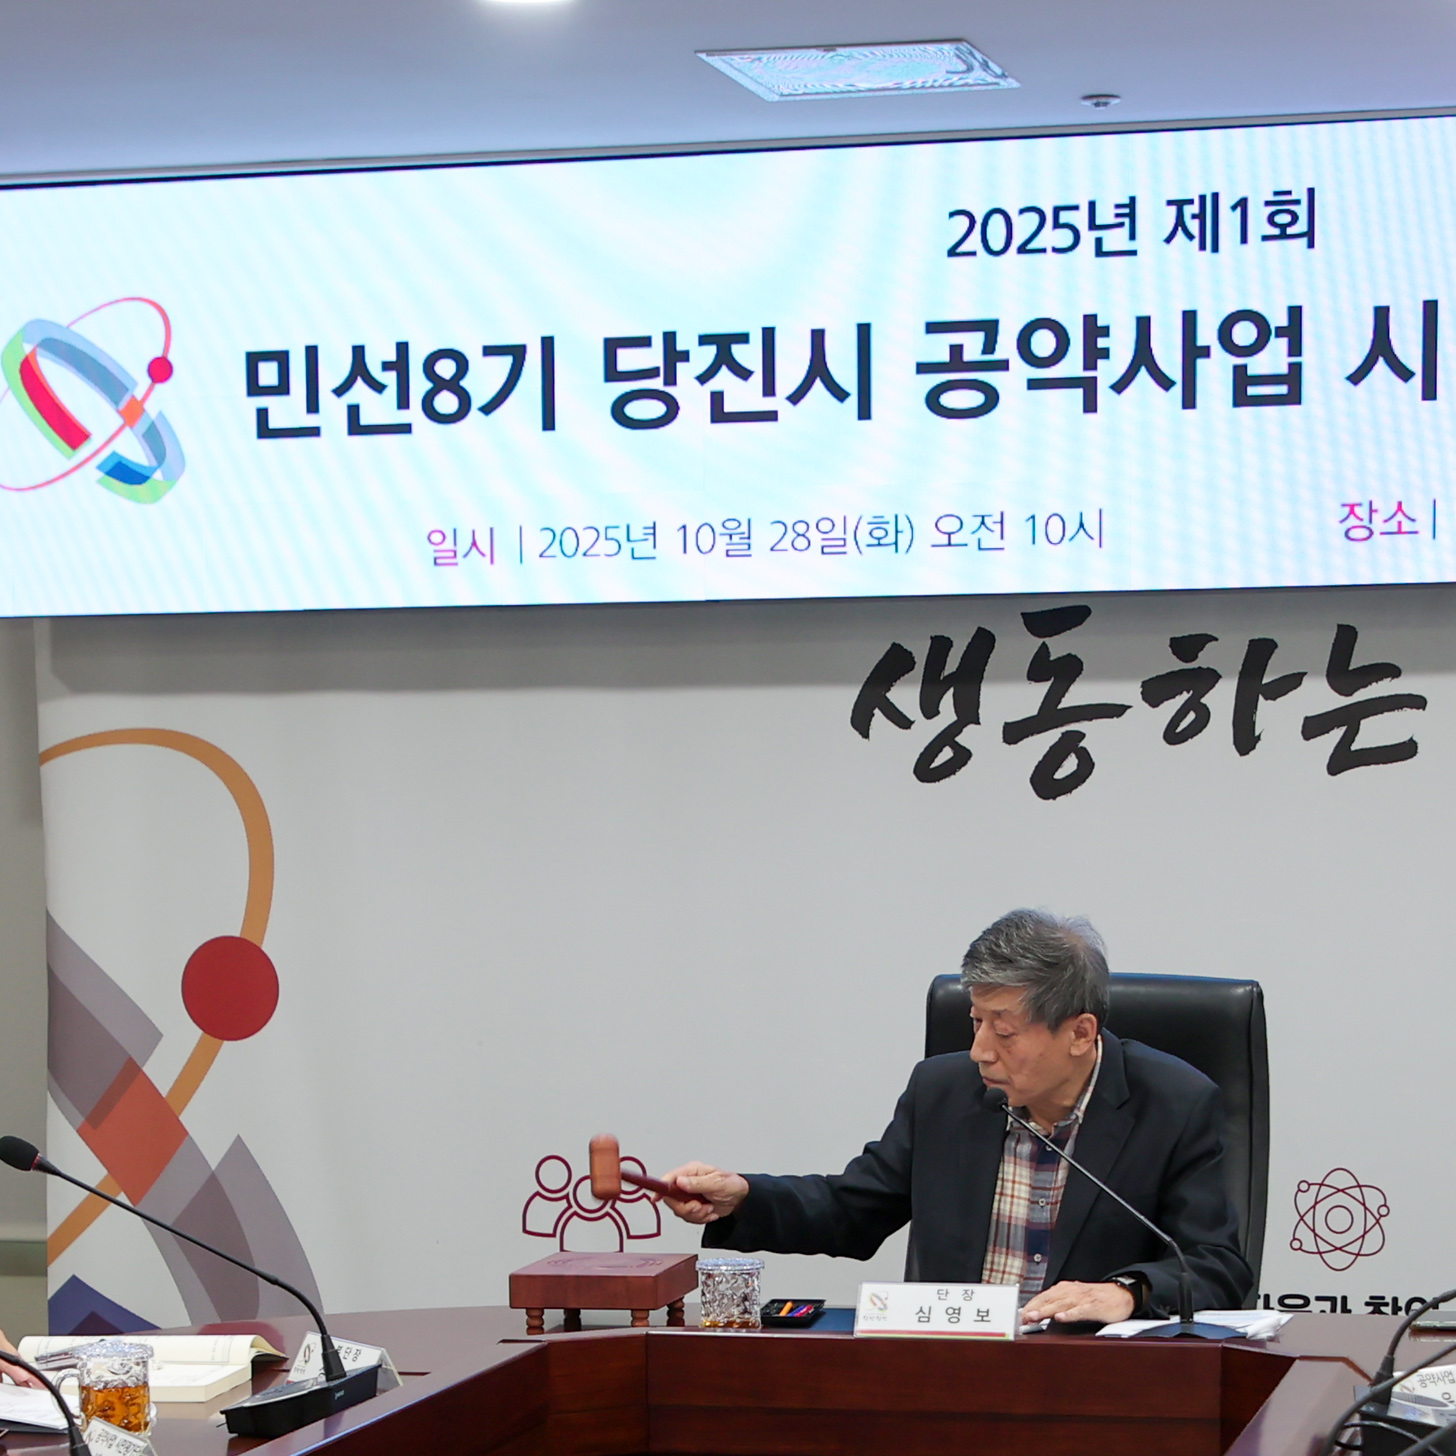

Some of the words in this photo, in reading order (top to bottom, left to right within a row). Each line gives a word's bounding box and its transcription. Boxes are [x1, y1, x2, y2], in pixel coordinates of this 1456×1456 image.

[946, 195, 1138, 259] 2025년
[1162, 186, 1316, 254] 제1회
[244, 334, 556, 440] 민선8기
[602, 321, 873, 431] 당진시
[915, 304, 1303, 420] 공약사업
[426, 526, 495, 567] 일시
[538, 520, 657, 562] 2025년
[677, 517, 753, 558] 10월
[769, 513, 915, 556] 28일(화)
[930, 510, 1005, 552] 오전
[1025, 508, 1104, 549] 10시
[1339, 499, 1420, 542] 장소
[850, 604, 1428, 801] 생동하는
[1417, 1371, 1455, 1388] 공약사업
